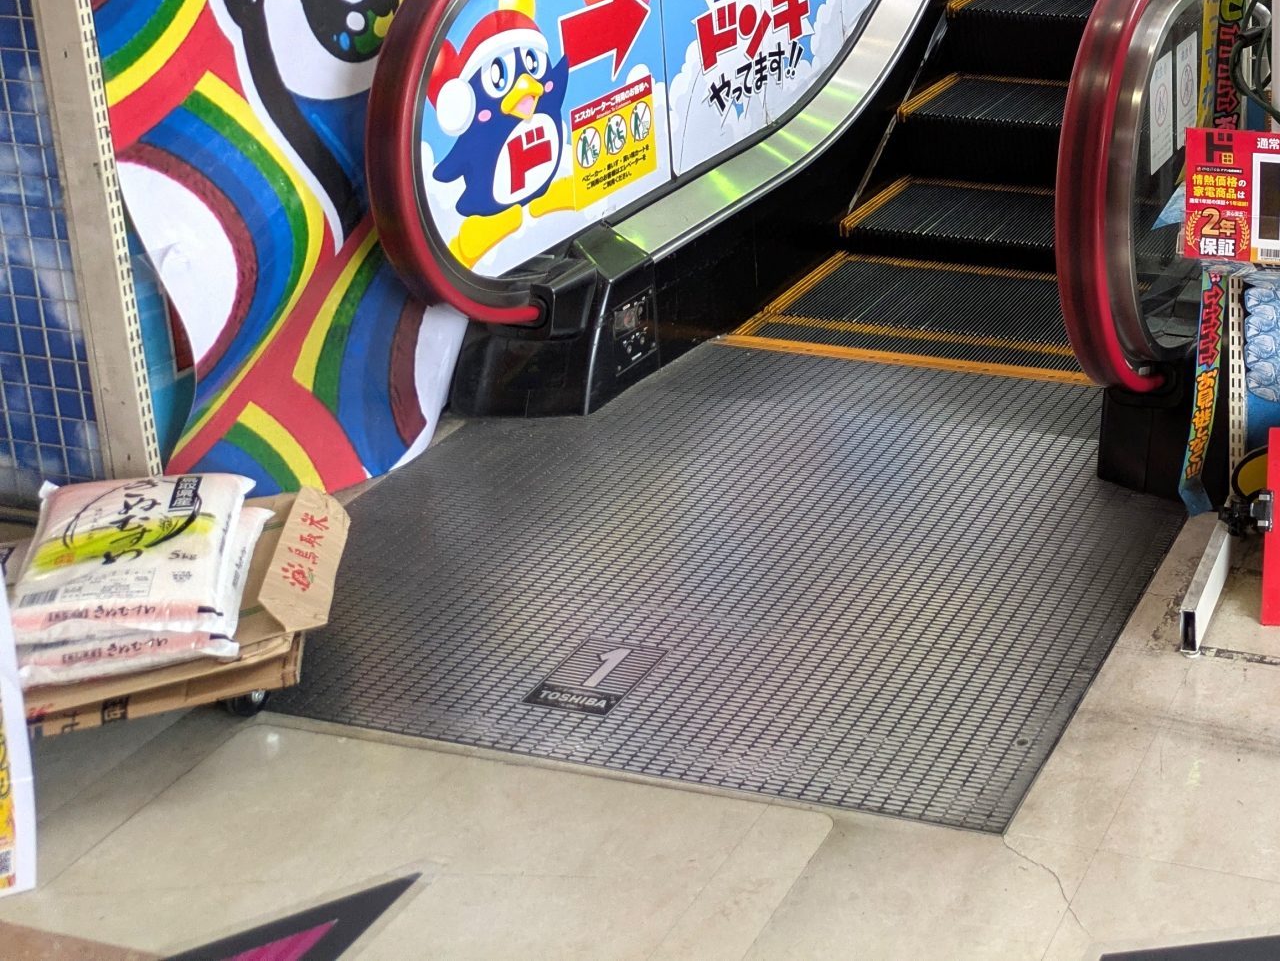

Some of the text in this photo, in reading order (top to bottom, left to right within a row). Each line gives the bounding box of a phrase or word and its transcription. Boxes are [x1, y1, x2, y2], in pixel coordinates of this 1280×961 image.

[509, 125, 553, 195] ド
[1192, 173, 1247, 188] 情熱価格の
[1193, 185, 1246, 199] 家電商品は
[1201, 207, 1236, 237] 2年
[1199, 236, 1236, 257] 保証
[582, 647, 633, 688] 1
[539, 690, 608, 709] TOSHIBA
